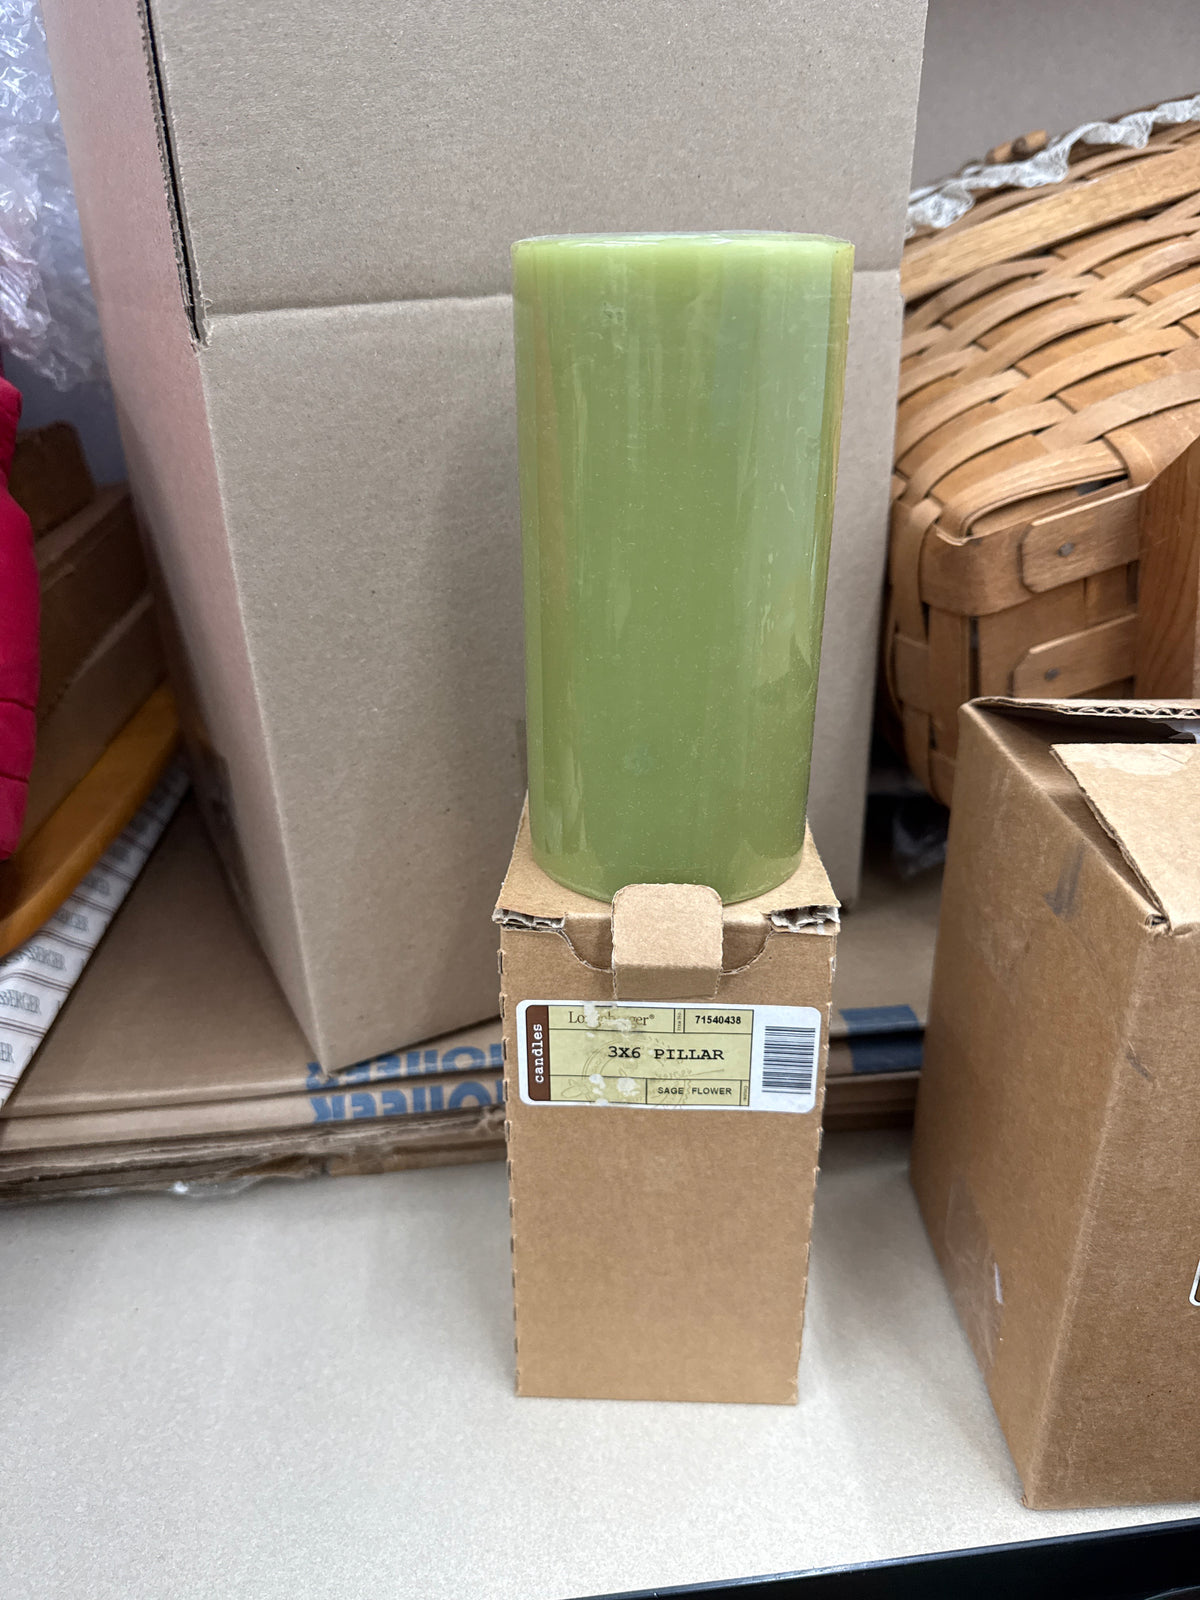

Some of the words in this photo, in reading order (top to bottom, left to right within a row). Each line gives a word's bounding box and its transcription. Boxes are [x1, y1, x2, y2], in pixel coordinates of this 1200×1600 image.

[695, 1015, 742, 1025] 71540438
[532, 1023, 545, 1084] candles
[607, 1046, 642, 1059] 3X6
[654, 1049, 725, 1060] PILLAR
[657, 1086, 685, 1095] SAGE
[691, 1087, 732, 1096] FLOWER
